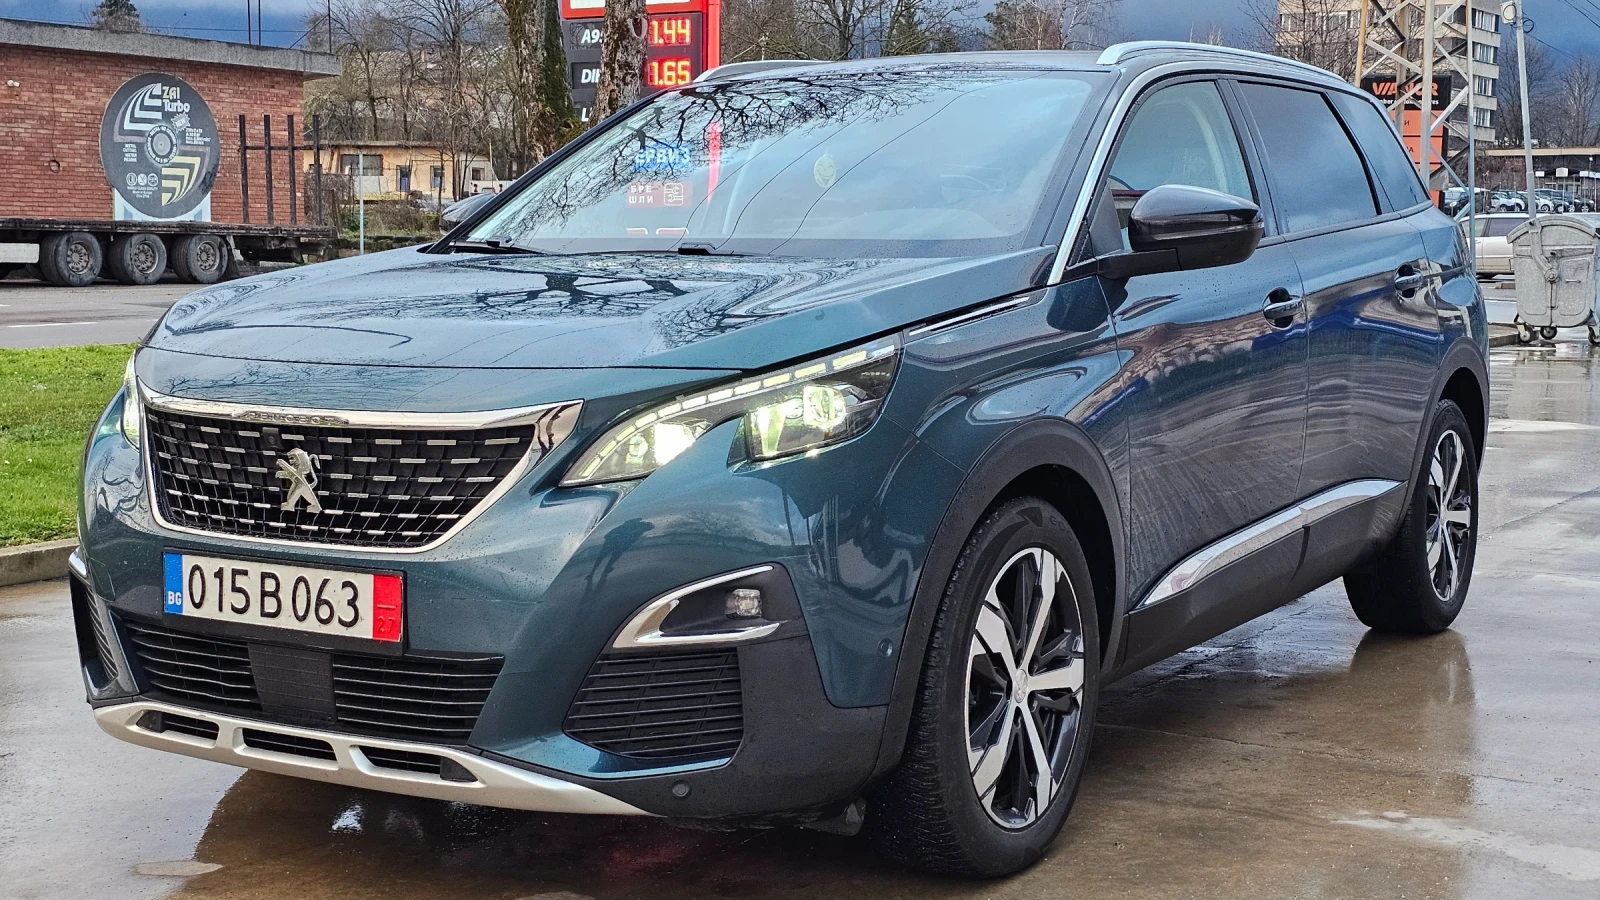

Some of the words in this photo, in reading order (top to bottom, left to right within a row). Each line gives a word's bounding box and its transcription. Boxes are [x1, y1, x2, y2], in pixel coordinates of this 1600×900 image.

[650, 19, 691, 44] 1.44
[650, 61, 691, 86] 1.65
[162, 86, 181, 100] ZAI
[162, 99, 191, 113] Turbo
[167, 590, 182, 606] BG
[377, 615, 395, 633] 27
